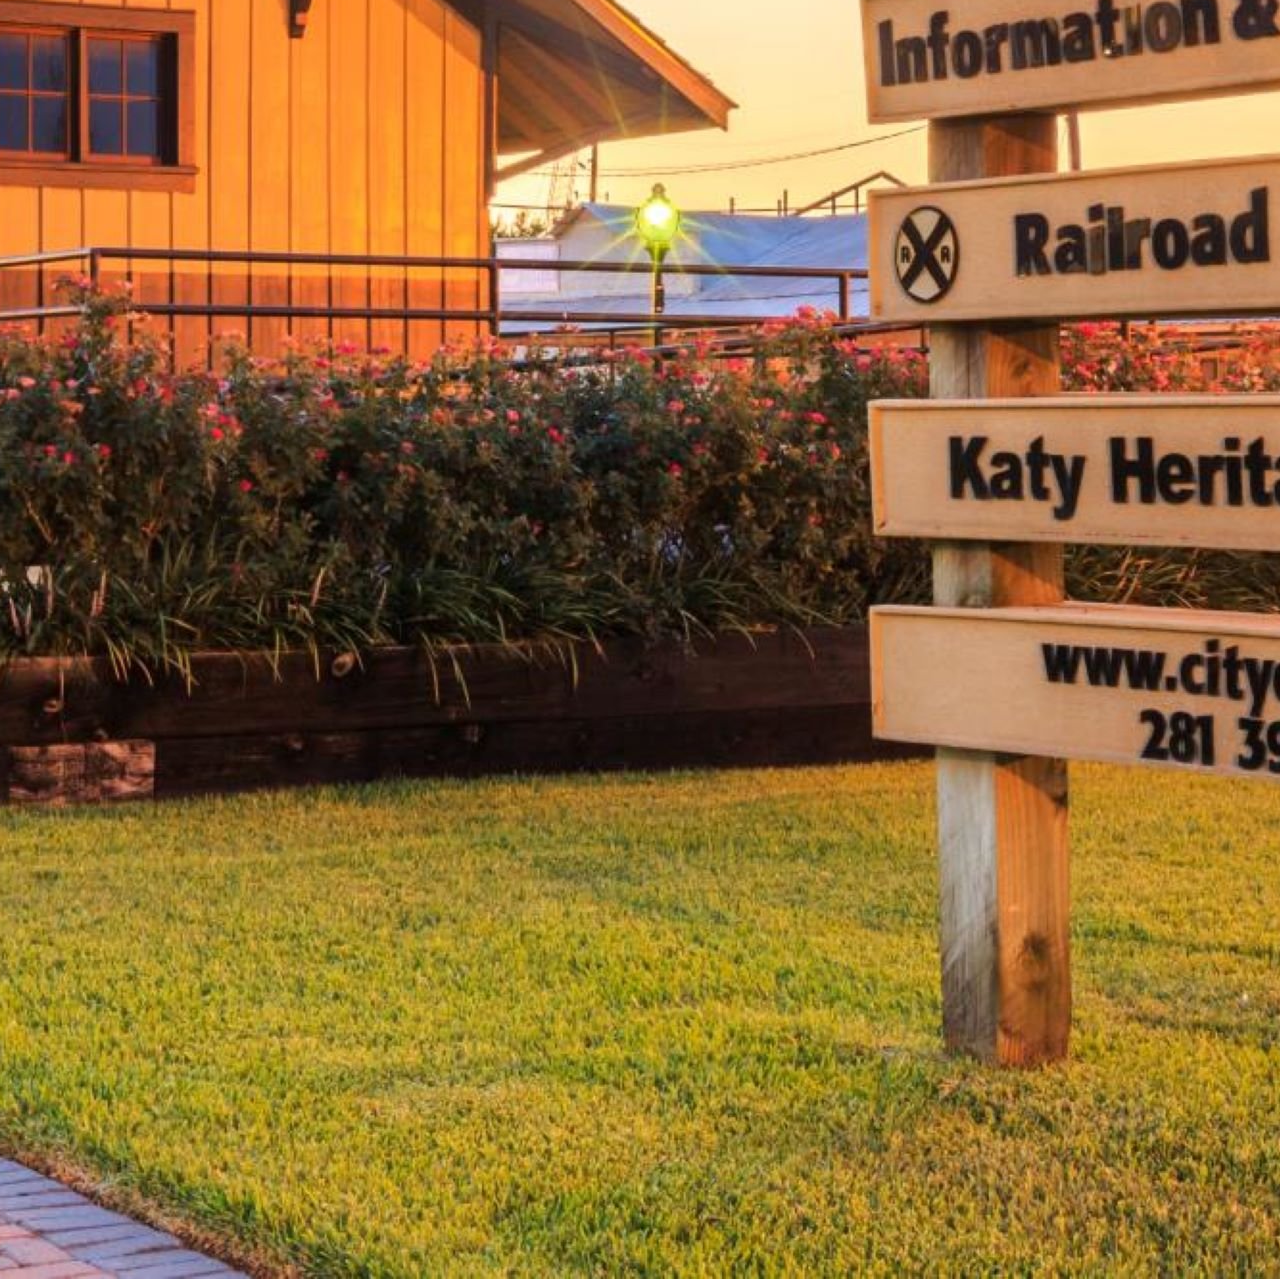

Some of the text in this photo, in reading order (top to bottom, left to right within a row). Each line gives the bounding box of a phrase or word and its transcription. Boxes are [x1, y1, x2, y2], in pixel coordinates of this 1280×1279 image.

[1014, 186, 1270, 277] Railroad
[949, 436, 1086, 521] Katy
[1139, 708, 1215, 767] 281
